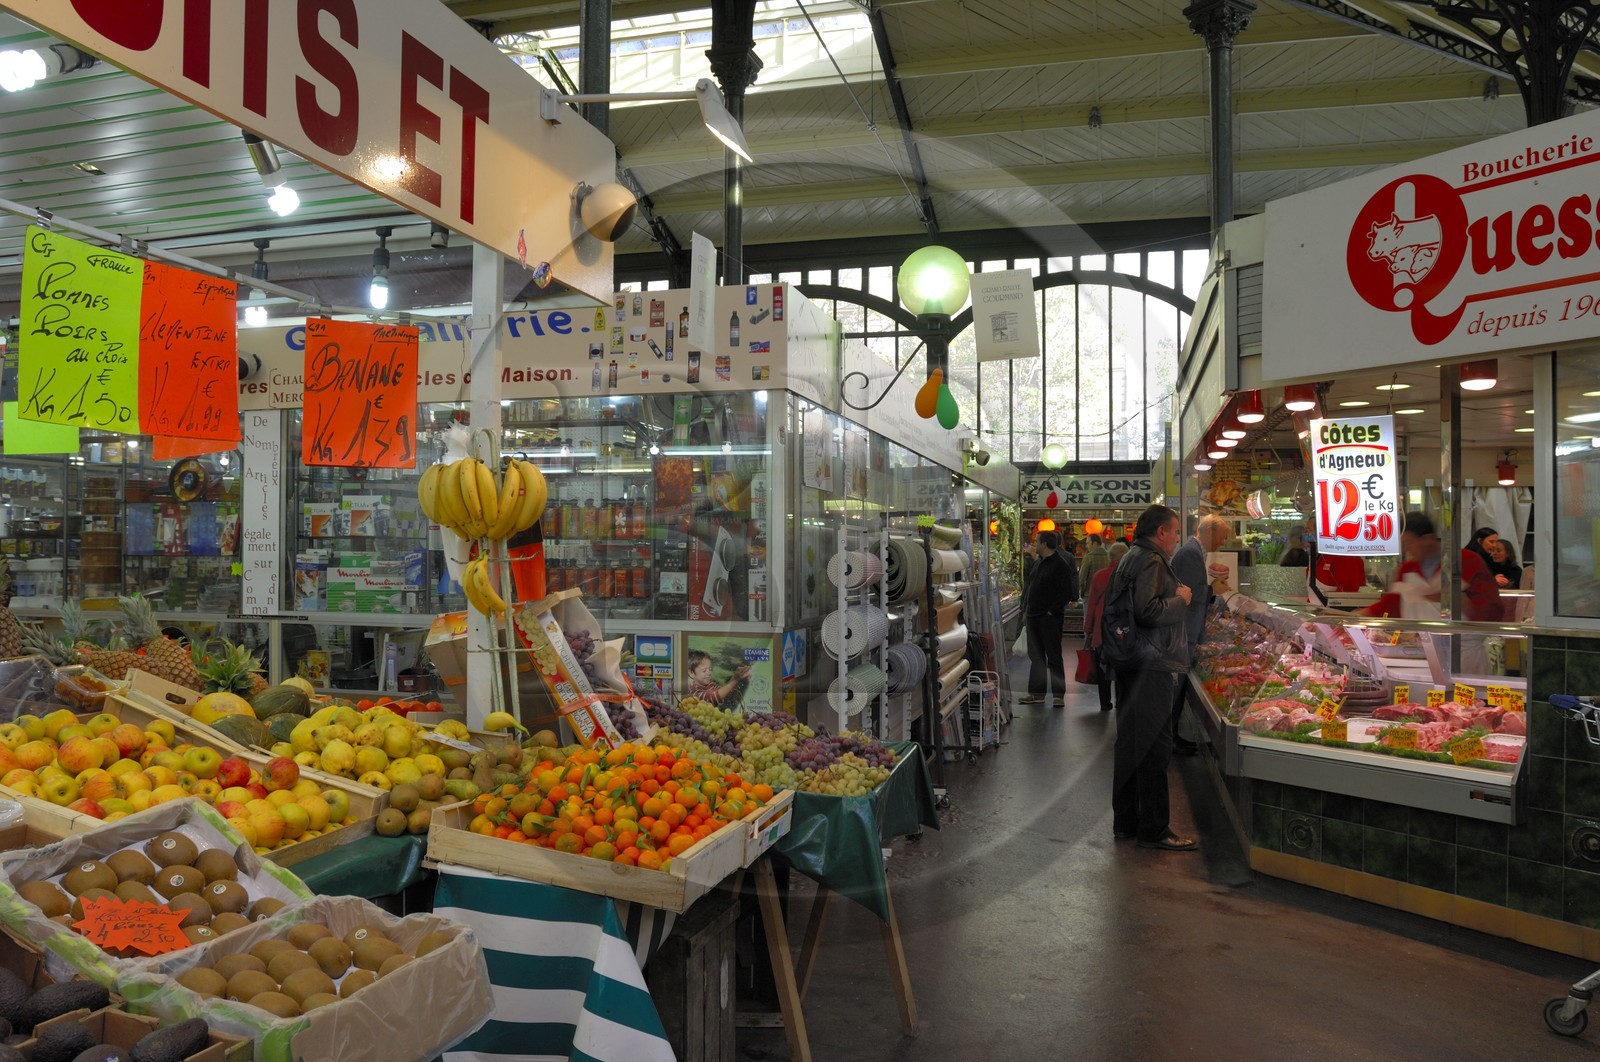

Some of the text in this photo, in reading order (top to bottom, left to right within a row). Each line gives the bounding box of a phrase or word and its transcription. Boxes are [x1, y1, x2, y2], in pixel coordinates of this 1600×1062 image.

[401, 29, 490, 225] ET
[1462, 134, 1593, 183] Boucherie
[1347, 174, 1600, 345] Ques
[1467, 304, 1548, 337] depuis
[273, 374, 304, 386] CHAU
[417, 371, 456, 386] cles
[239, 381, 268, 394] res
[273, 392, 303, 404] MERC
[253, 415, 268, 427] De
[1320, 423, 1380, 444] Côtes
[1320, 454, 1386, 471] d'Agneau
[1026, 480, 1151, 491] SALAISONS
[1064, 493, 1151, 504] RETAGN
[1316, 479, 1362, 541] 12
[1365, 500, 1394, 513] le Kg
[1364, 513, 1393, 541] 50
[244, 528, 271, 543] égale
[248, 542, 276, 551] ment
[254, 560, 273, 568] sur
[640, 643, 668, 656] CB
[563, 682, 595, 733] L'ETIHETTA
